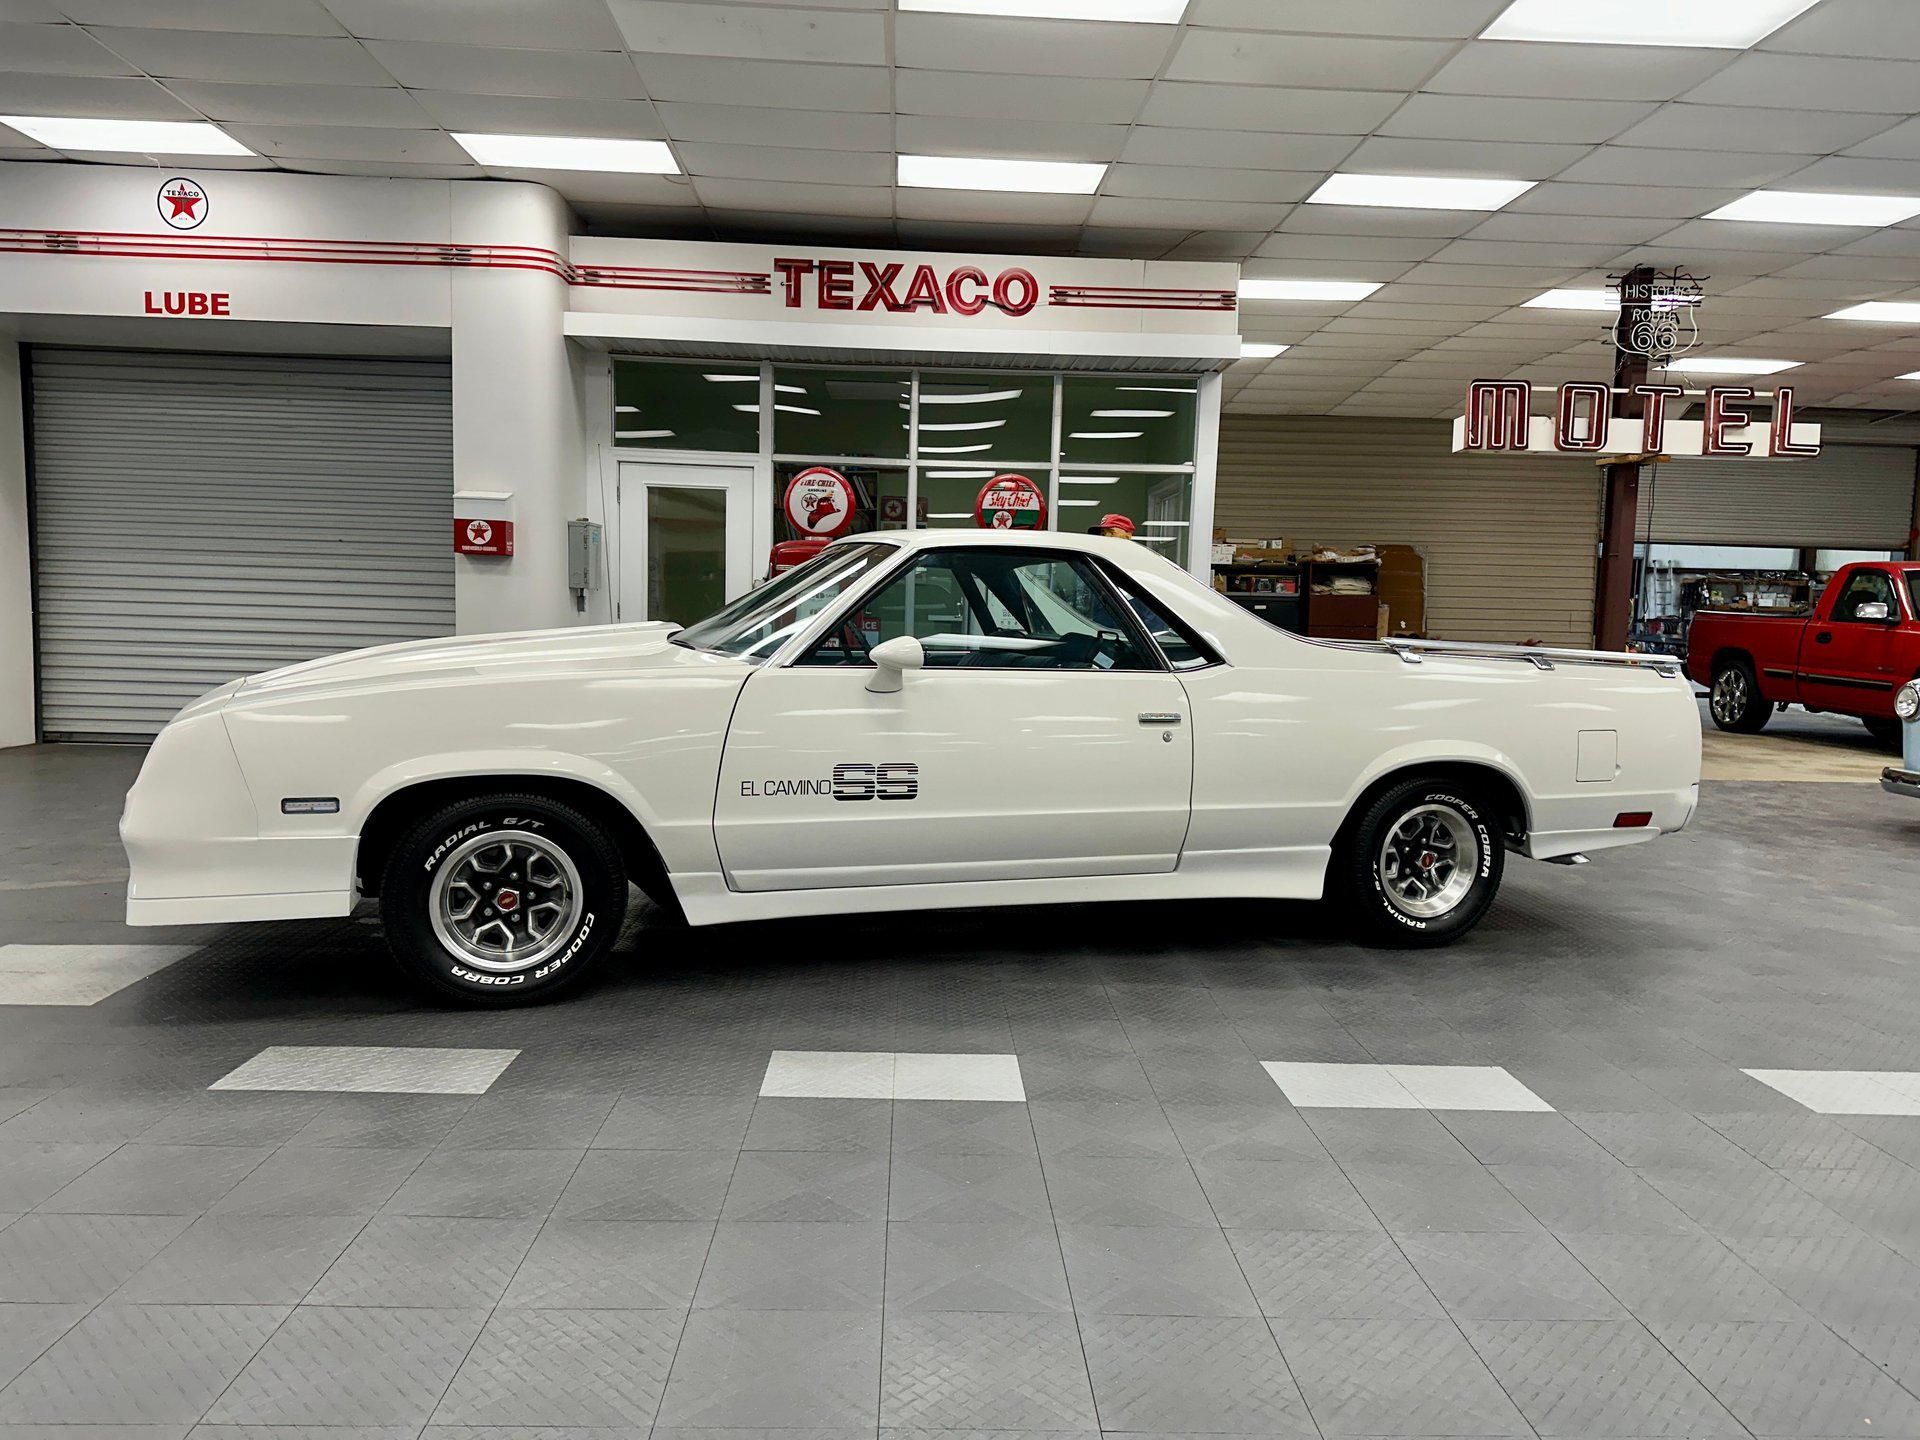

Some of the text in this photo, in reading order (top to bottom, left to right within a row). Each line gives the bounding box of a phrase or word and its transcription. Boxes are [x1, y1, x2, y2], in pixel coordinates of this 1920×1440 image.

[145, 292, 230, 316] LUBE
[774, 258, 1039, 317] TEXACO
[1625, 284, 1691, 298] HISTORIC
[1632, 308, 1677, 322] ROUTE
[1631, 321, 1679, 352] 66
[1464, 379, 1824, 457] MOTEL
[989, 491, 1033, 508] Sky Chief
[740, 762, 919, 801] EL CAMINO SS
[424, 817, 545, 872] RADIAL G/T
[1425, 794, 1491, 878] COOPER COBRA
[1382, 896, 1427, 929] RADIAL
[451, 912, 595, 985] COOPER COBRA
